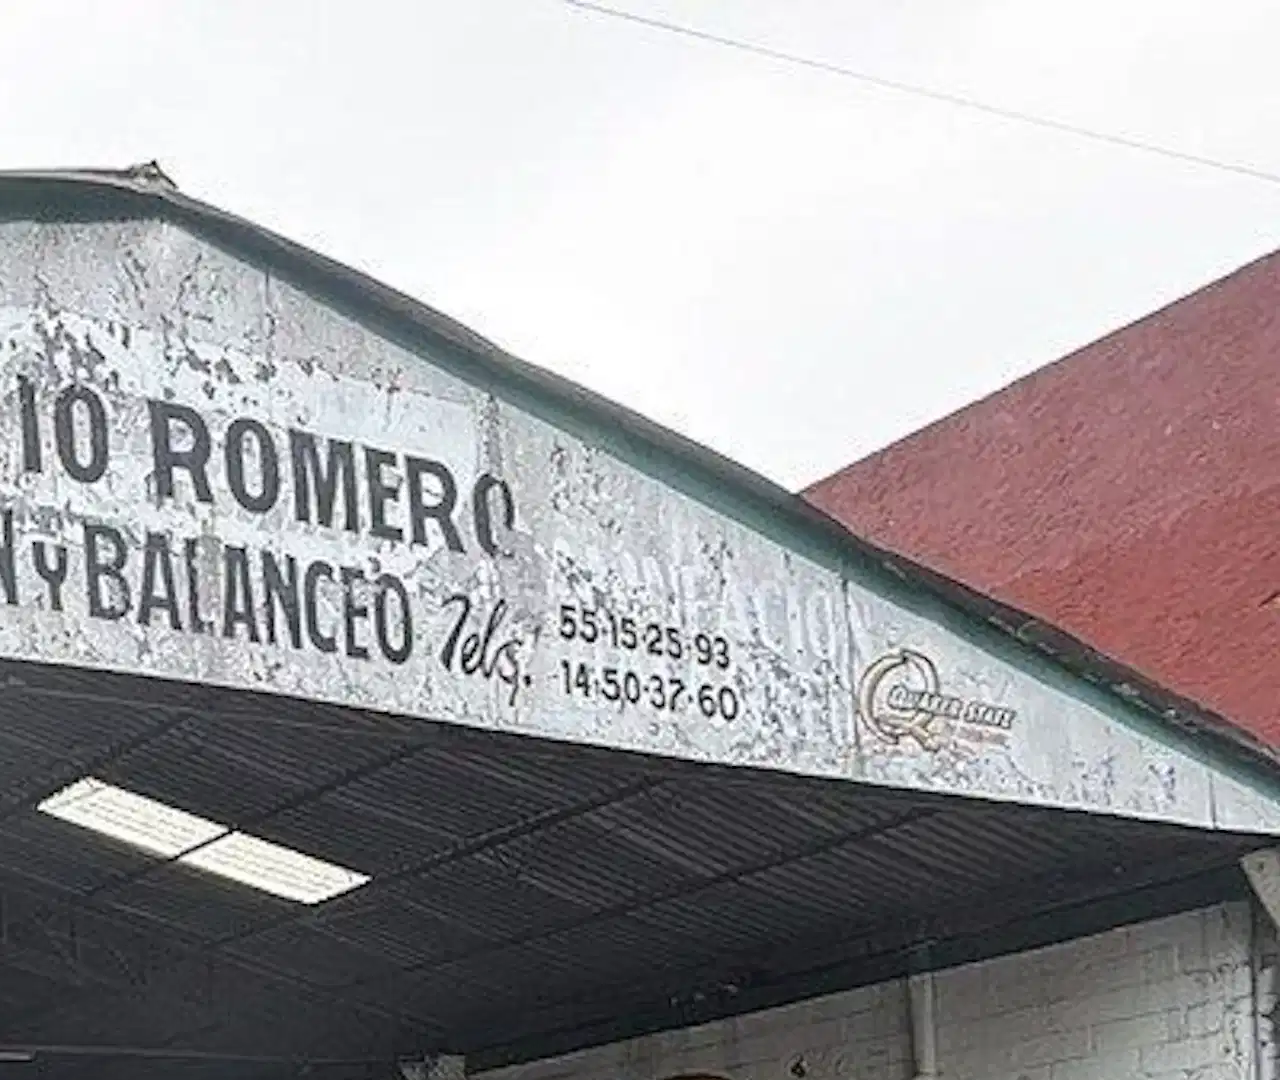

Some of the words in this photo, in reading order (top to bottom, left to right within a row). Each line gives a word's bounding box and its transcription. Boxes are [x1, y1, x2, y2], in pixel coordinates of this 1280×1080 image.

[147, 398, 515, 557] ROMERO
[32, 540, 67, 611] Y
[85, 524, 414, 665] BALANCEO
